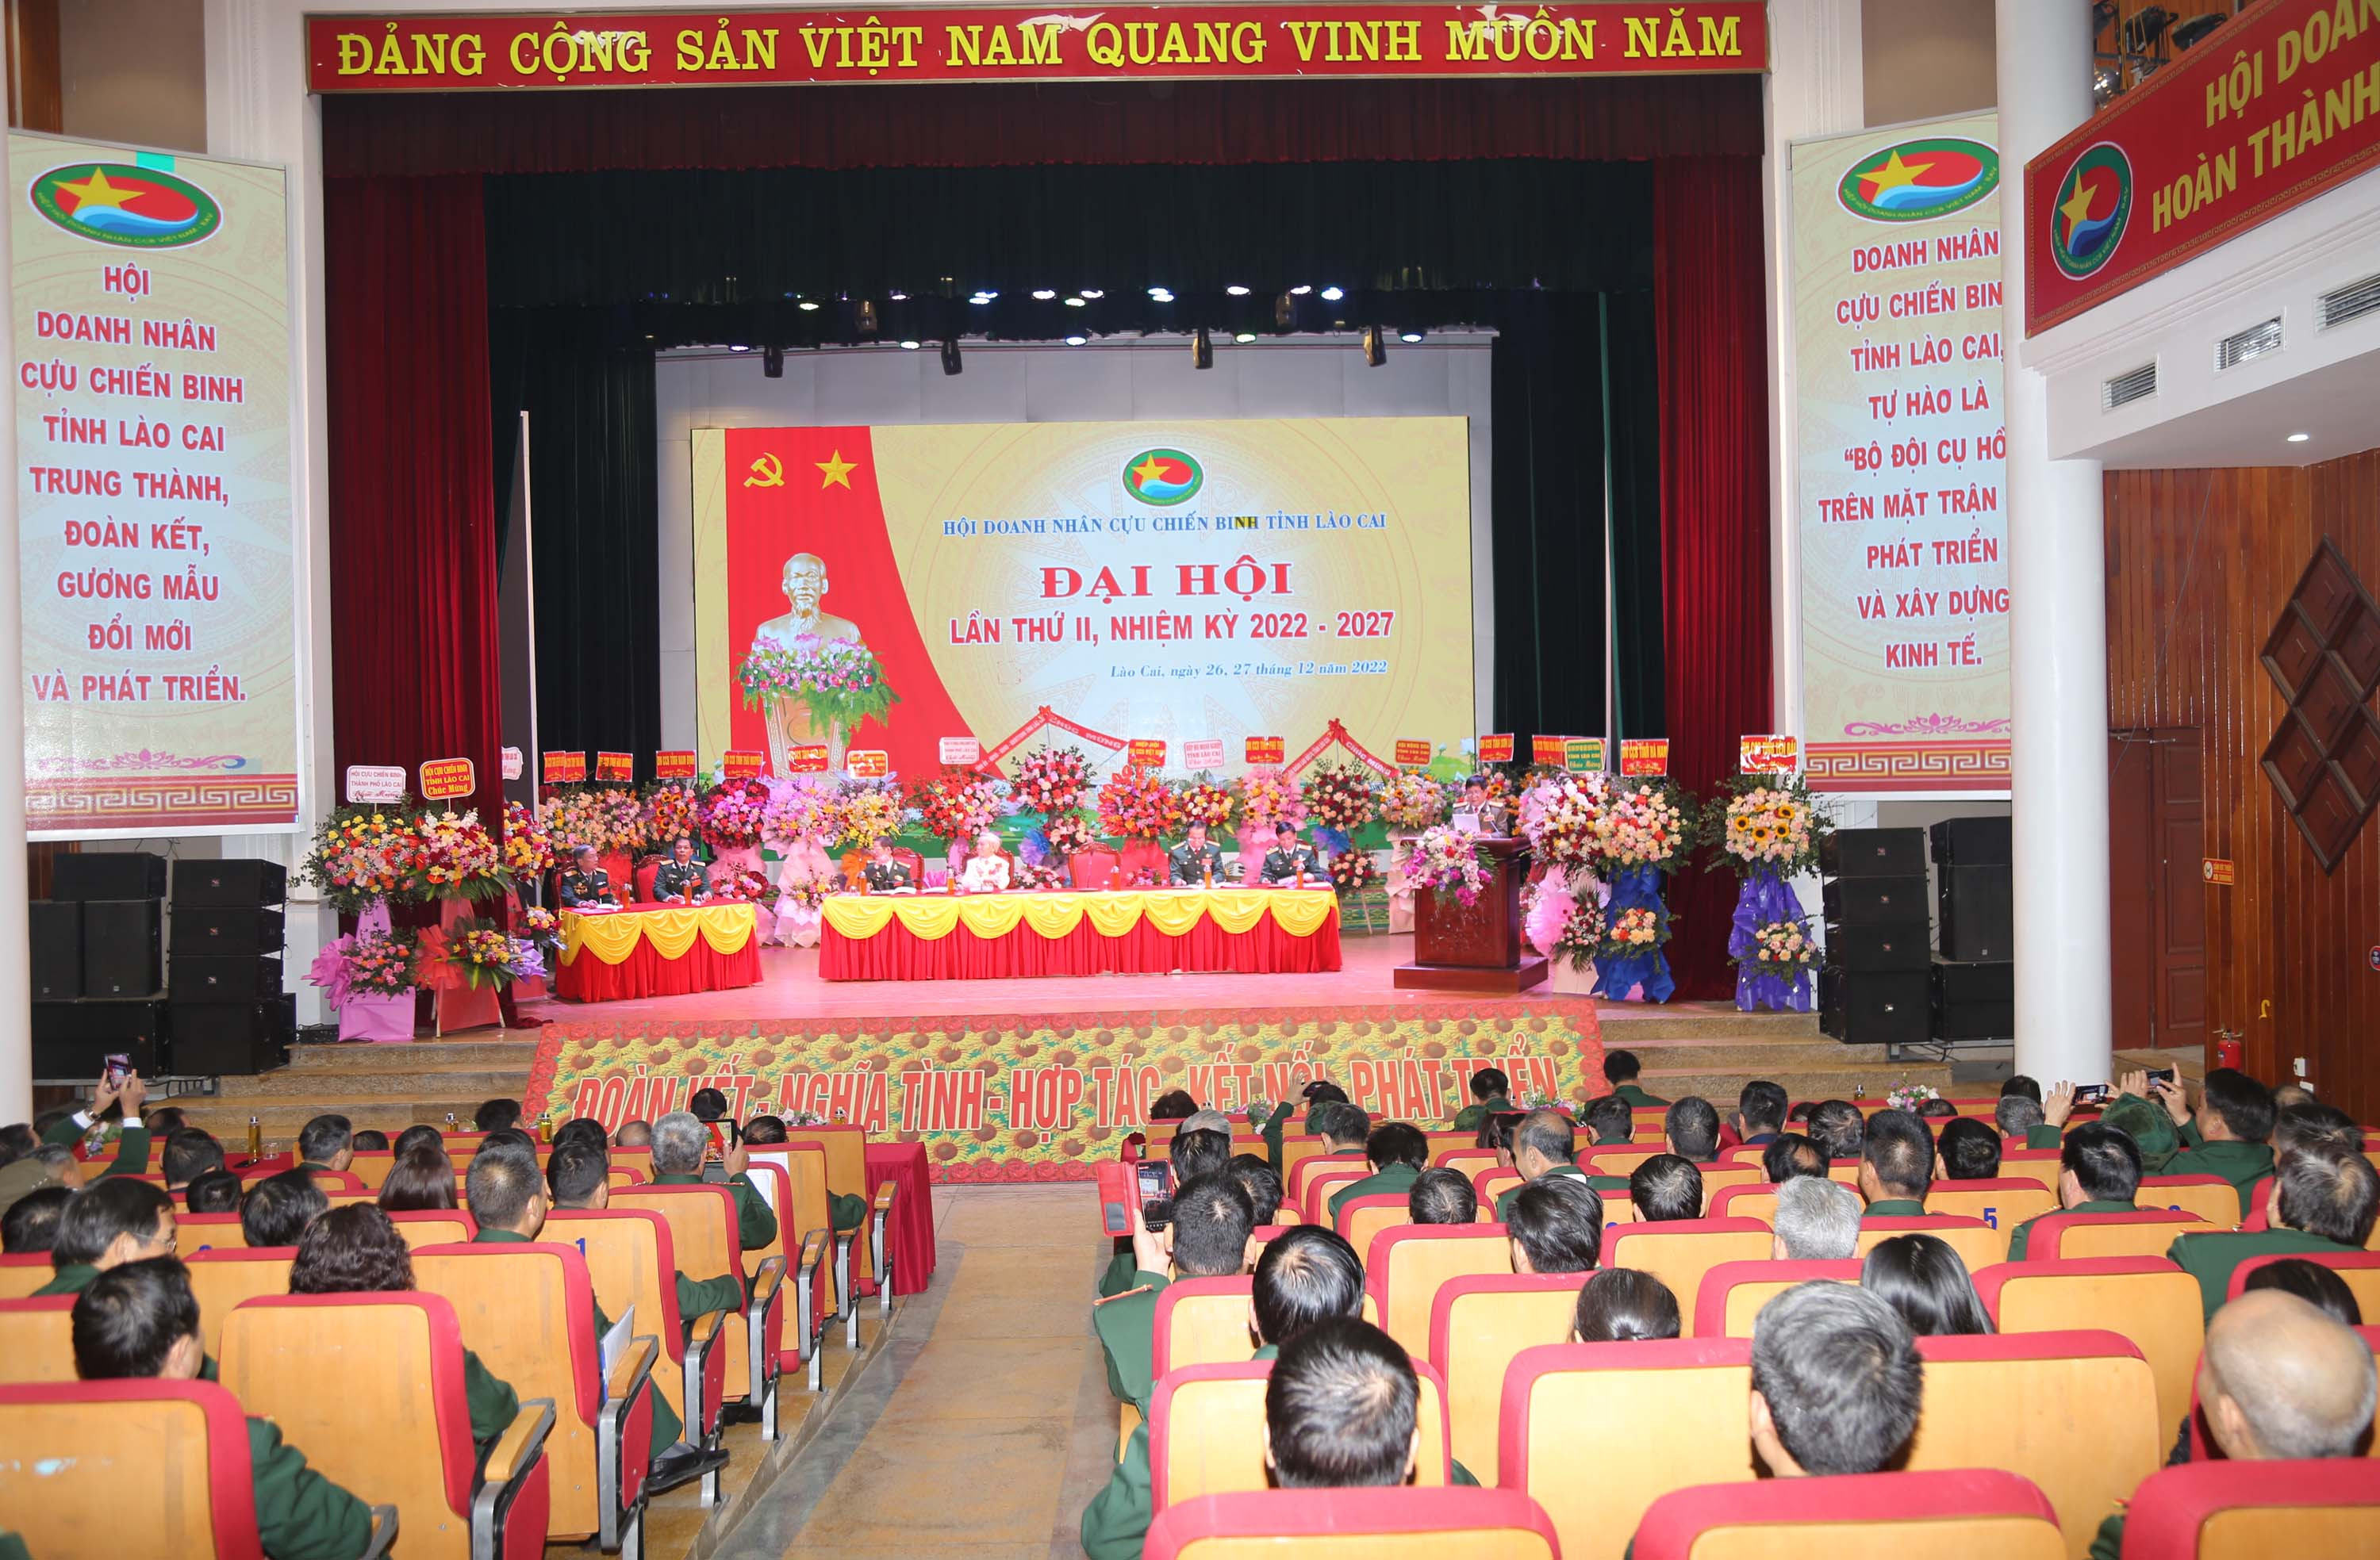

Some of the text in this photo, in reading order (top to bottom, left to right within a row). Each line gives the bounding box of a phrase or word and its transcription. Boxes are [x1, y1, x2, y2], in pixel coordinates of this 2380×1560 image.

[338, 7, 1741, 82] ĐẢNG CỘNG SẢN VIỆT NAM QUANG VINH MUÔN NĂM
[2206, 51, 2262, 128] HỘI
[2153, 146, 2236, 233] HOÀN
[2248, 61, 2380, 178] THÀNH
[1853, 228, 1999, 273] DOANH NHÂN
[105, 263, 148, 301] HỘI
[1837, 281, 2002, 330] CỰU CHIẾN BIN
[37, 311, 216, 351] DOANH NHÂN
[1851, 339, 1900, 371] TỈNH
[1910, 334, 1952, 366] LÀO
[21, 359, 243, 403] CỰU CHIẾN BINH
[1869, 380, 1989, 425] TỰ HÀO LÀ
[44, 408, 224, 451] TỈNH LÀO CAI
[1891, 438, 1926, 473] ĐỘI
[1937, 439, 1966, 470] CỤ
[1977, 426, 2006, 460] HỒ
[29, 467, 228, 506] TRUNG THÀNH,
[1818, 483, 1997, 524] TRÊN MẶT TRẬN
[65, 516, 209, 555] ĐOÀN KẾT,
[943, 512, 1386, 538] HỘI DOANH NHÂN CỰU CHIẾN BINH TỈNH LÀO CAI
[1867, 528, 1998, 569] PHÁT TRIỂN
[58, 564, 219, 600] GƯƠNG MẪU
[1039, 555, 1293, 604] ĐẠI HỘI
[1858, 585, 2010, 621] VÀ XÂY DỰNG
[88, 613, 191, 650] ĐỔI MỚI
[950, 610, 1000, 644] LẦN
[1012, 611, 1065, 642] THỨ
[1077, 616, 1100, 647] II,
[1111, 611, 1192, 648] NHIỆM
[1205, 608, 1238, 640] KỲ
[1250, 613, 1308, 638] 2022
[1338, 611, 1395, 637] 2027
[1111, 665, 1135, 678] Lào
[1140, 665, 1165, 679] Cai,
[1171, 665, 1201, 680] ngày
[1234, 663, 1252, 675] 27
[1256, 662, 1292, 677] tháng
[1299, 661, 1315, 674] 12
[1319, 661, 1347, 674] năm
[1352, 661, 1388, 673] 2022
[1887, 633, 1982, 668] KINH TẾ.
[32, 665, 246, 701] VÀ PHÁT TRIỂN.
[1345, 741, 1367, 760] CHÚC
[573, 1064, 678, 1139] ĐOÀN
[776, 1060, 889, 1133] NGHĨA
[901, 1058, 985, 1131] TÌNH
[988, 1096, 1003, 1110] -
[1010, 1063, 1084, 1144] HỢP
[1092, 1053, 1161, 1128] TÁC
[1188, 1041, 1253, 1113] KẾT
[1349, 1046, 1444, 1120] PHÁT
[1983, 1208, 1997, 1230] 5
